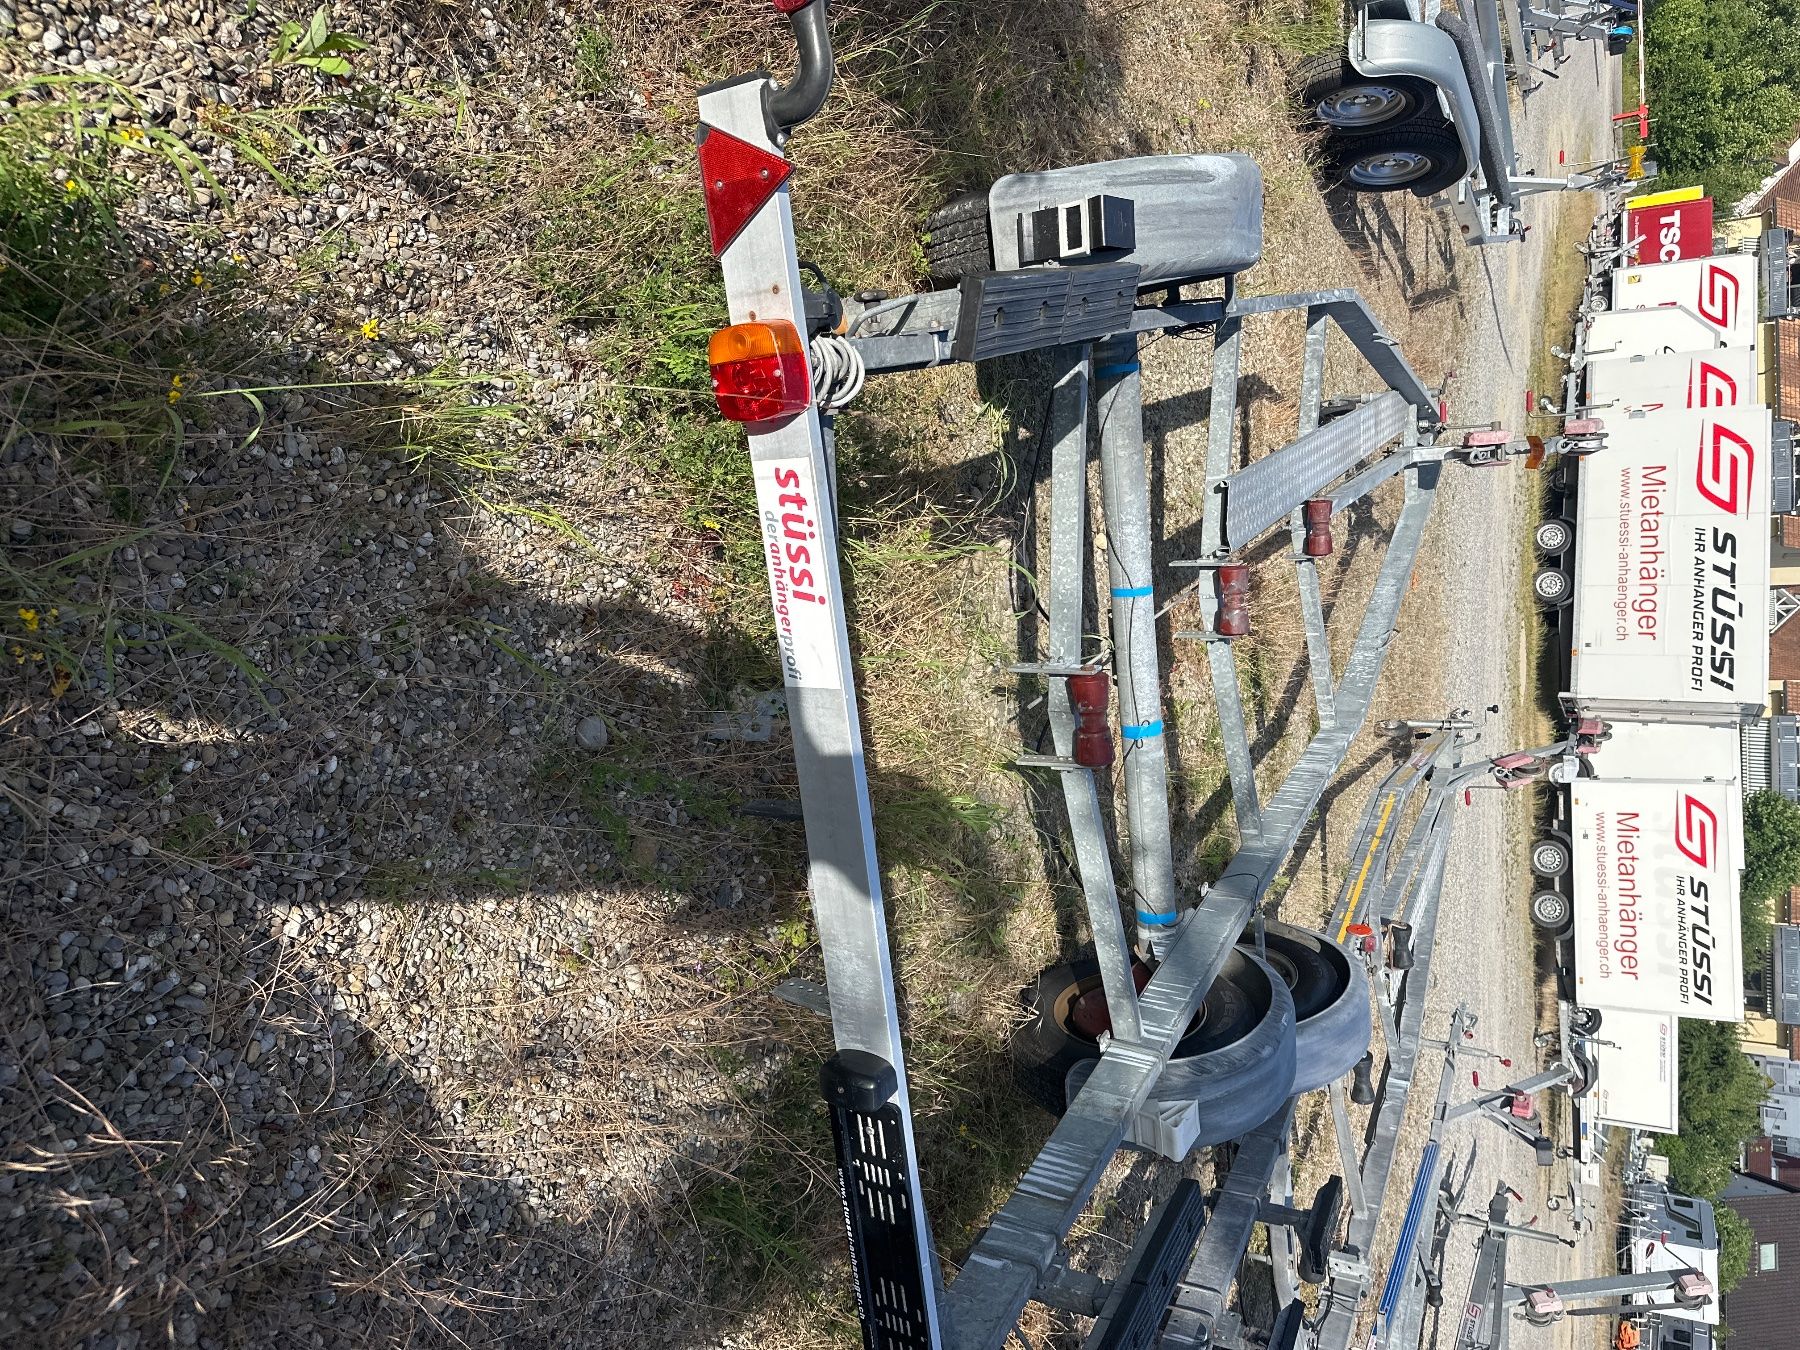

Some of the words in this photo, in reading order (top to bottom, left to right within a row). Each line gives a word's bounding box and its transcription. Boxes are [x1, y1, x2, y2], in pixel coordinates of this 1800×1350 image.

[764, 510, 803, 681] deranhängerprofi
[774, 467, 826, 605] stüssi
[1614, 467, 1633, 641] www.stuessi-anhaenger.ch
[1631, 465, 1667, 641] Mietanhänger
[1694, 527, 1706, 553] IHR
[1691, 645, 1704, 692] PROFI
[1595, 811, 1612, 979] www.stuessi-anhaenger.ch
[1613, 812, 1643, 980] Mietanhänger
[1675, 875, 1686, 896] IHR
[1675, 898, 1690, 965] ANHÄNGER
[1689, 875, 1716, 1006] STÜSSI
[1679, 968, 1689, 1004] PROFI
[837, 1167, 866, 1320] www.stuessi-anhaenger.ch
